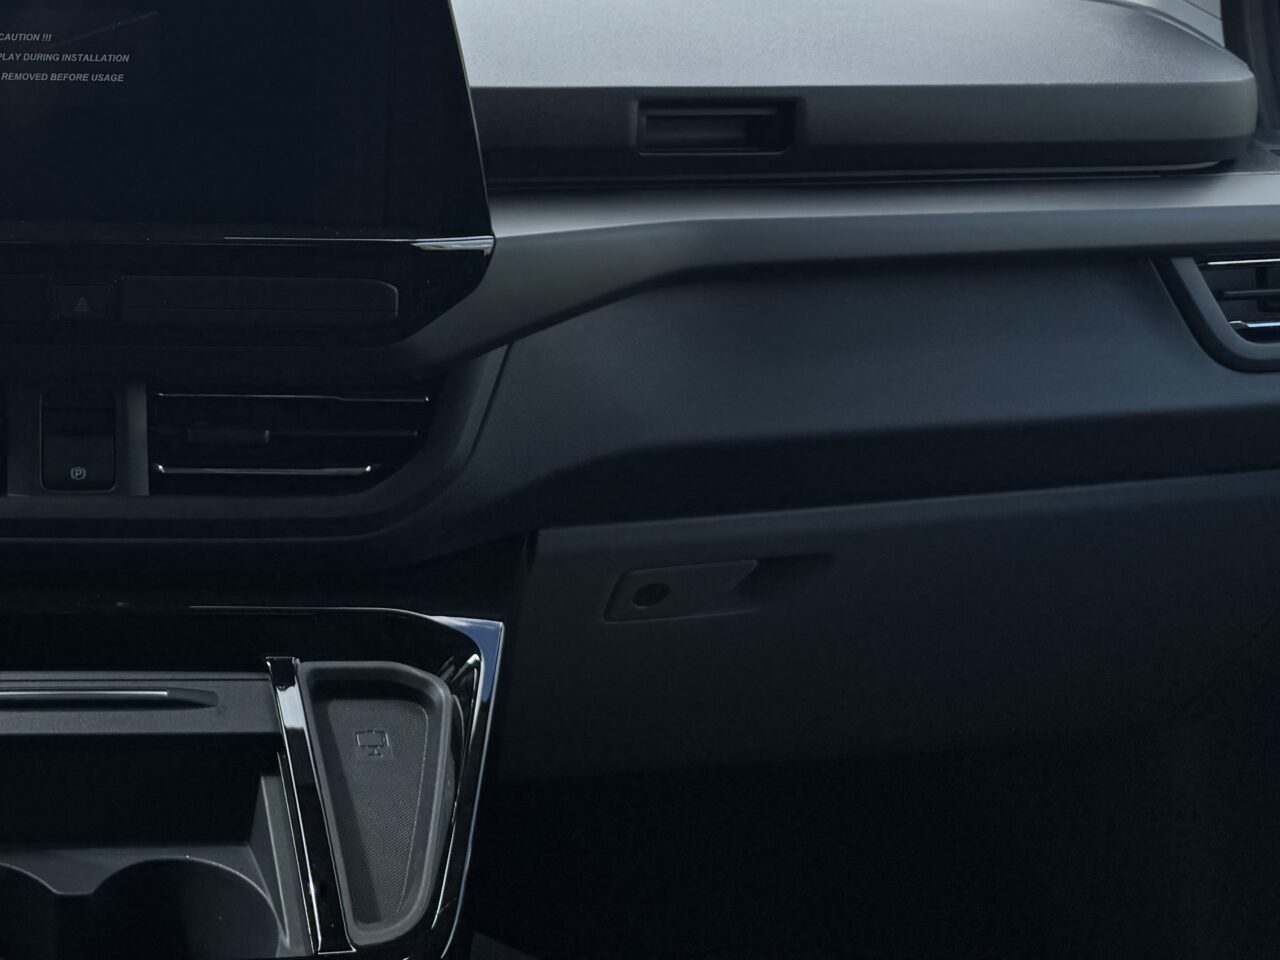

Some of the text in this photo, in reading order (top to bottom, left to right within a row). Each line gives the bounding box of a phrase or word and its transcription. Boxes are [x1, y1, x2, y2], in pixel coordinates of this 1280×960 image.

[23, 53, 59, 62] DURING
[61, 53, 130, 63] INSTALLATION
[1, 72, 48, 82] REMOVED
[50, 73, 90, 82] BEFORE
[91, 73, 125, 83] USAGE
